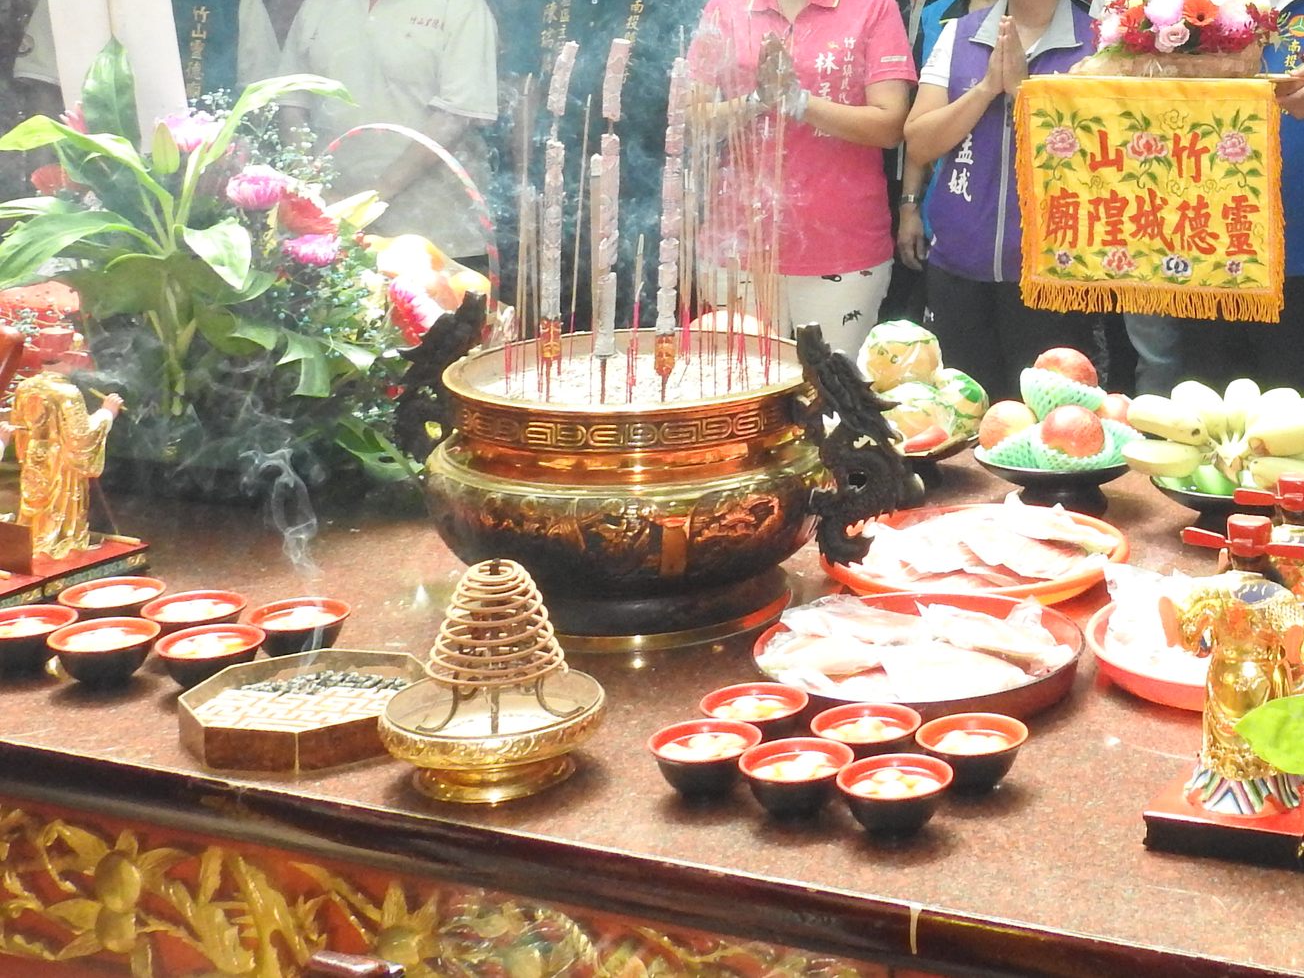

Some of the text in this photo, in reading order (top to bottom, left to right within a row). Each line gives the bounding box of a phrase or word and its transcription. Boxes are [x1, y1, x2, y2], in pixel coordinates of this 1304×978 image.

[1043, 187, 1260, 257] 靈德城隍廟
